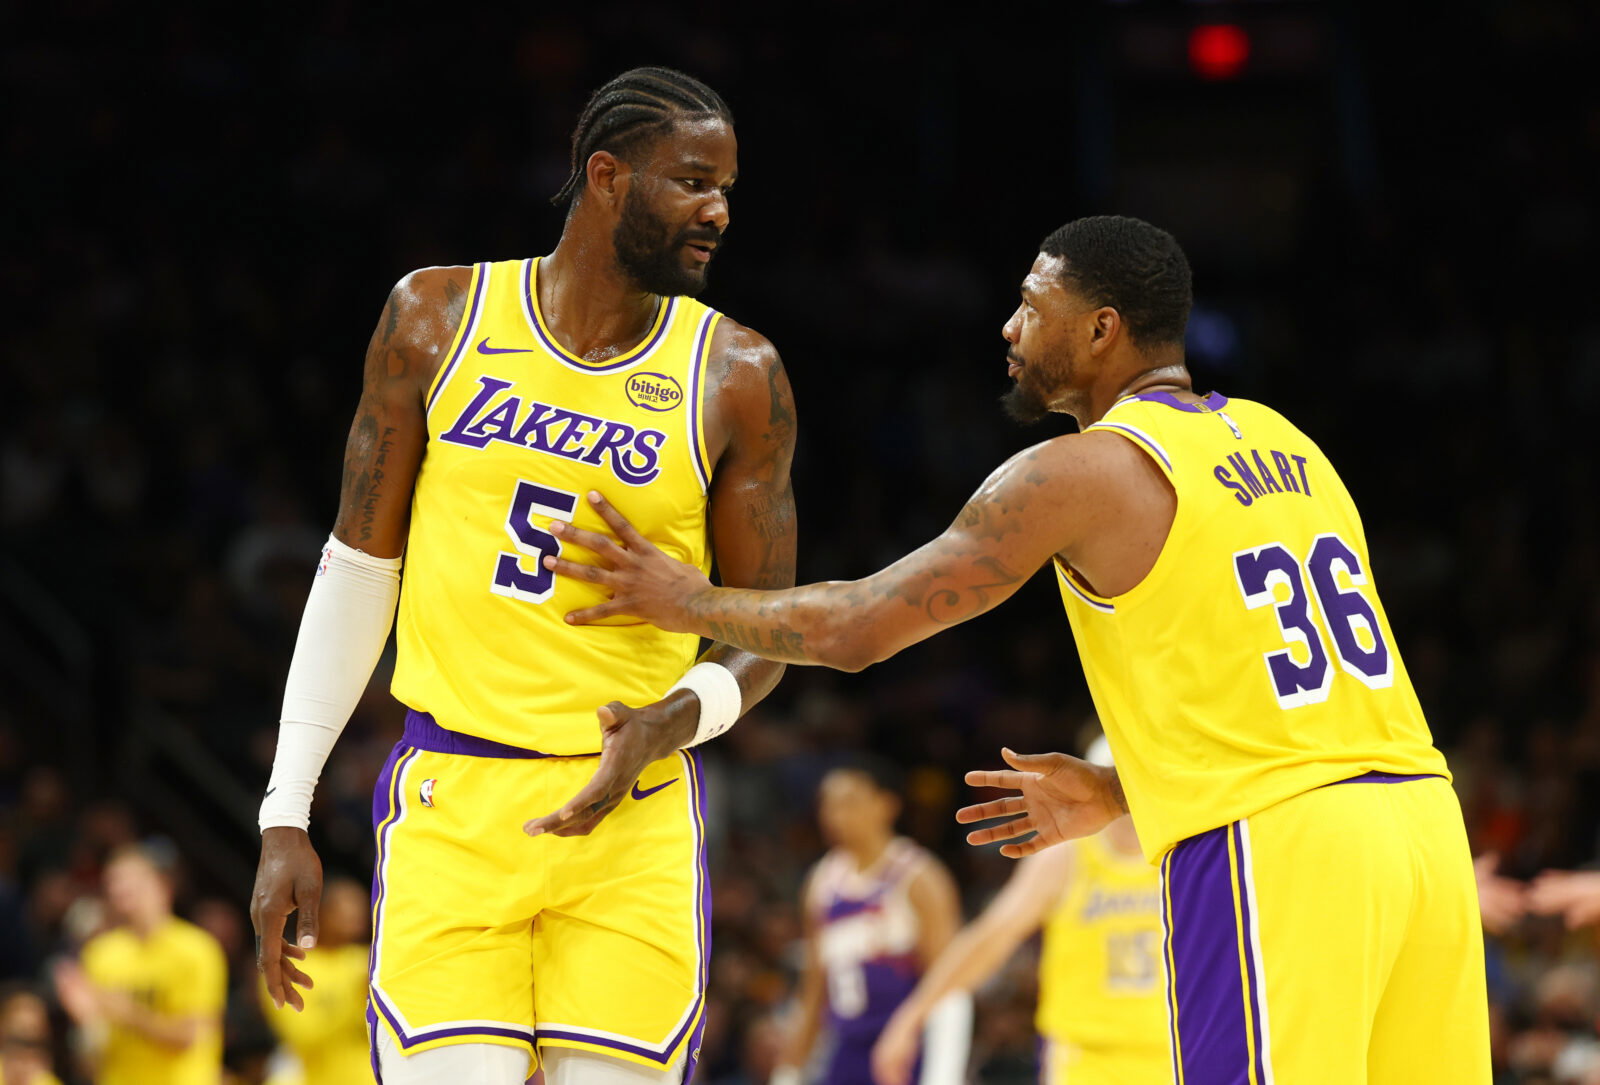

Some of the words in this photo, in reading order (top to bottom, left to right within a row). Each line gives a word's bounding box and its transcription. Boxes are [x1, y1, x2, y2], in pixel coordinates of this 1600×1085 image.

[440, 375, 666, 487] LAKERS
[631, 379, 680, 402] bibigo
[1213, 449, 1312, 507] SMART
[490, 478, 580, 605] 5
[1232, 532, 1394, 710] 36
